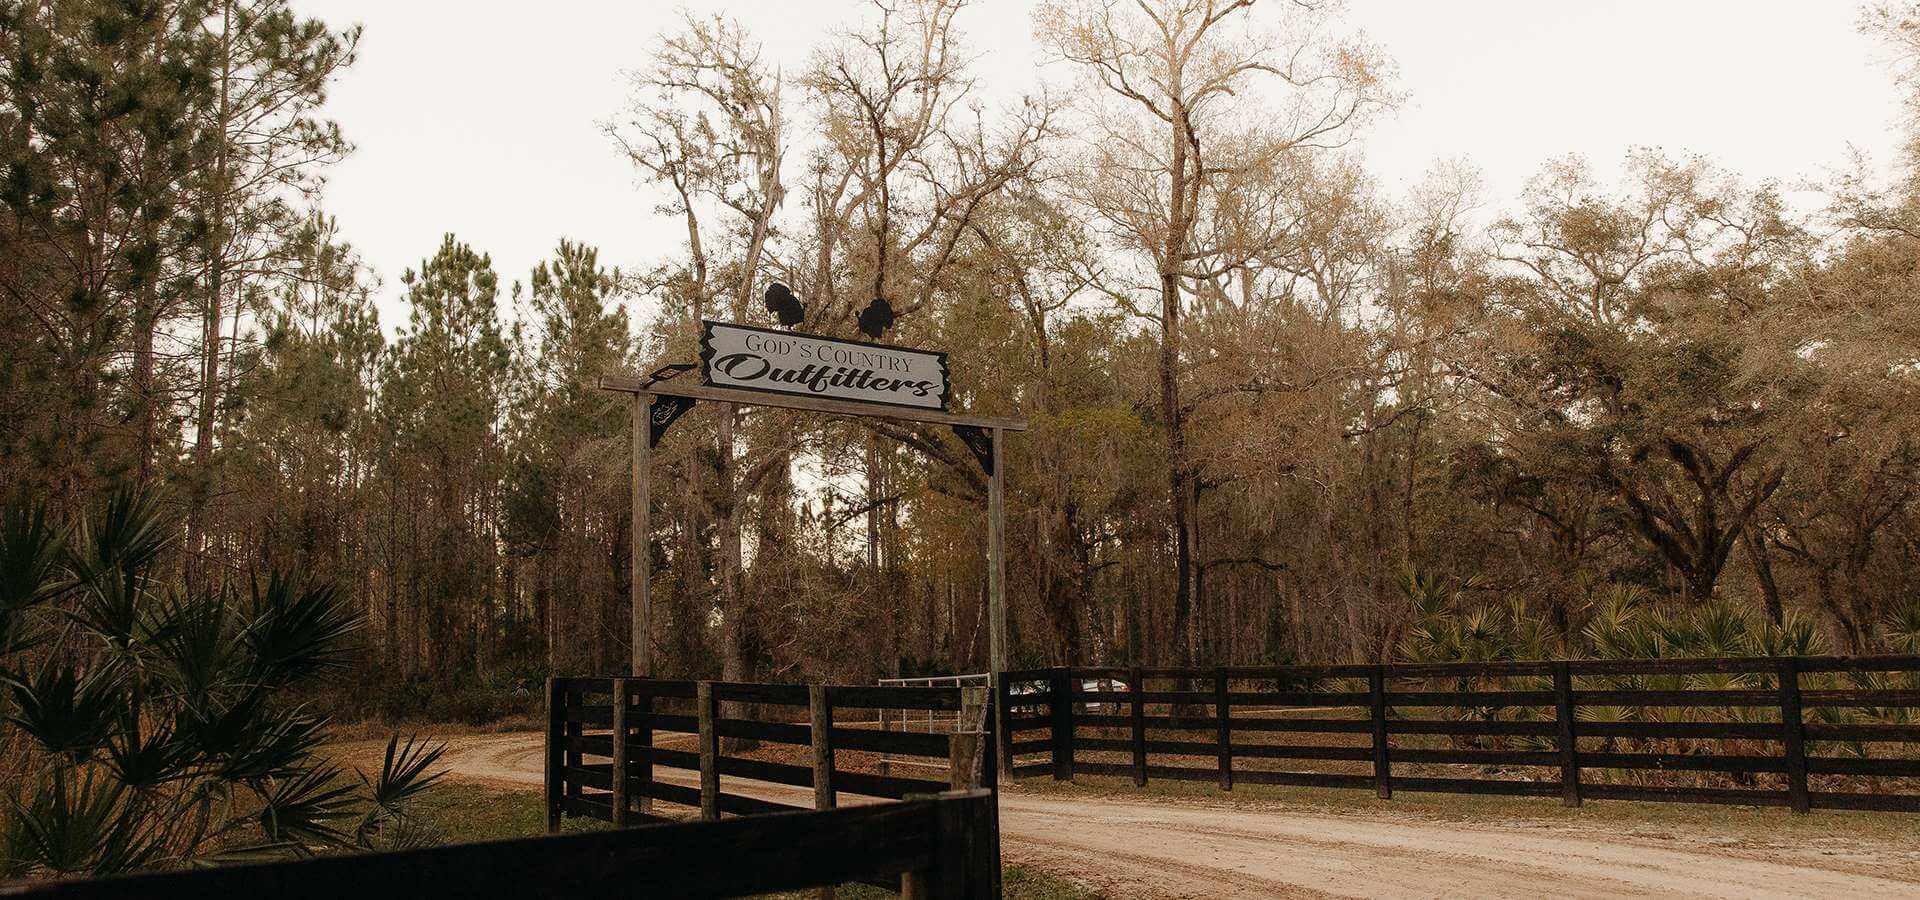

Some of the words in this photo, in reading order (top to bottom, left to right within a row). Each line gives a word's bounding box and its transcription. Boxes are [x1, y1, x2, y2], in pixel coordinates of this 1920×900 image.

[745, 333, 812, 360] GOD'S
[817, 345, 913, 373] COUNTRY
[714, 353, 940, 397] Outfitters
